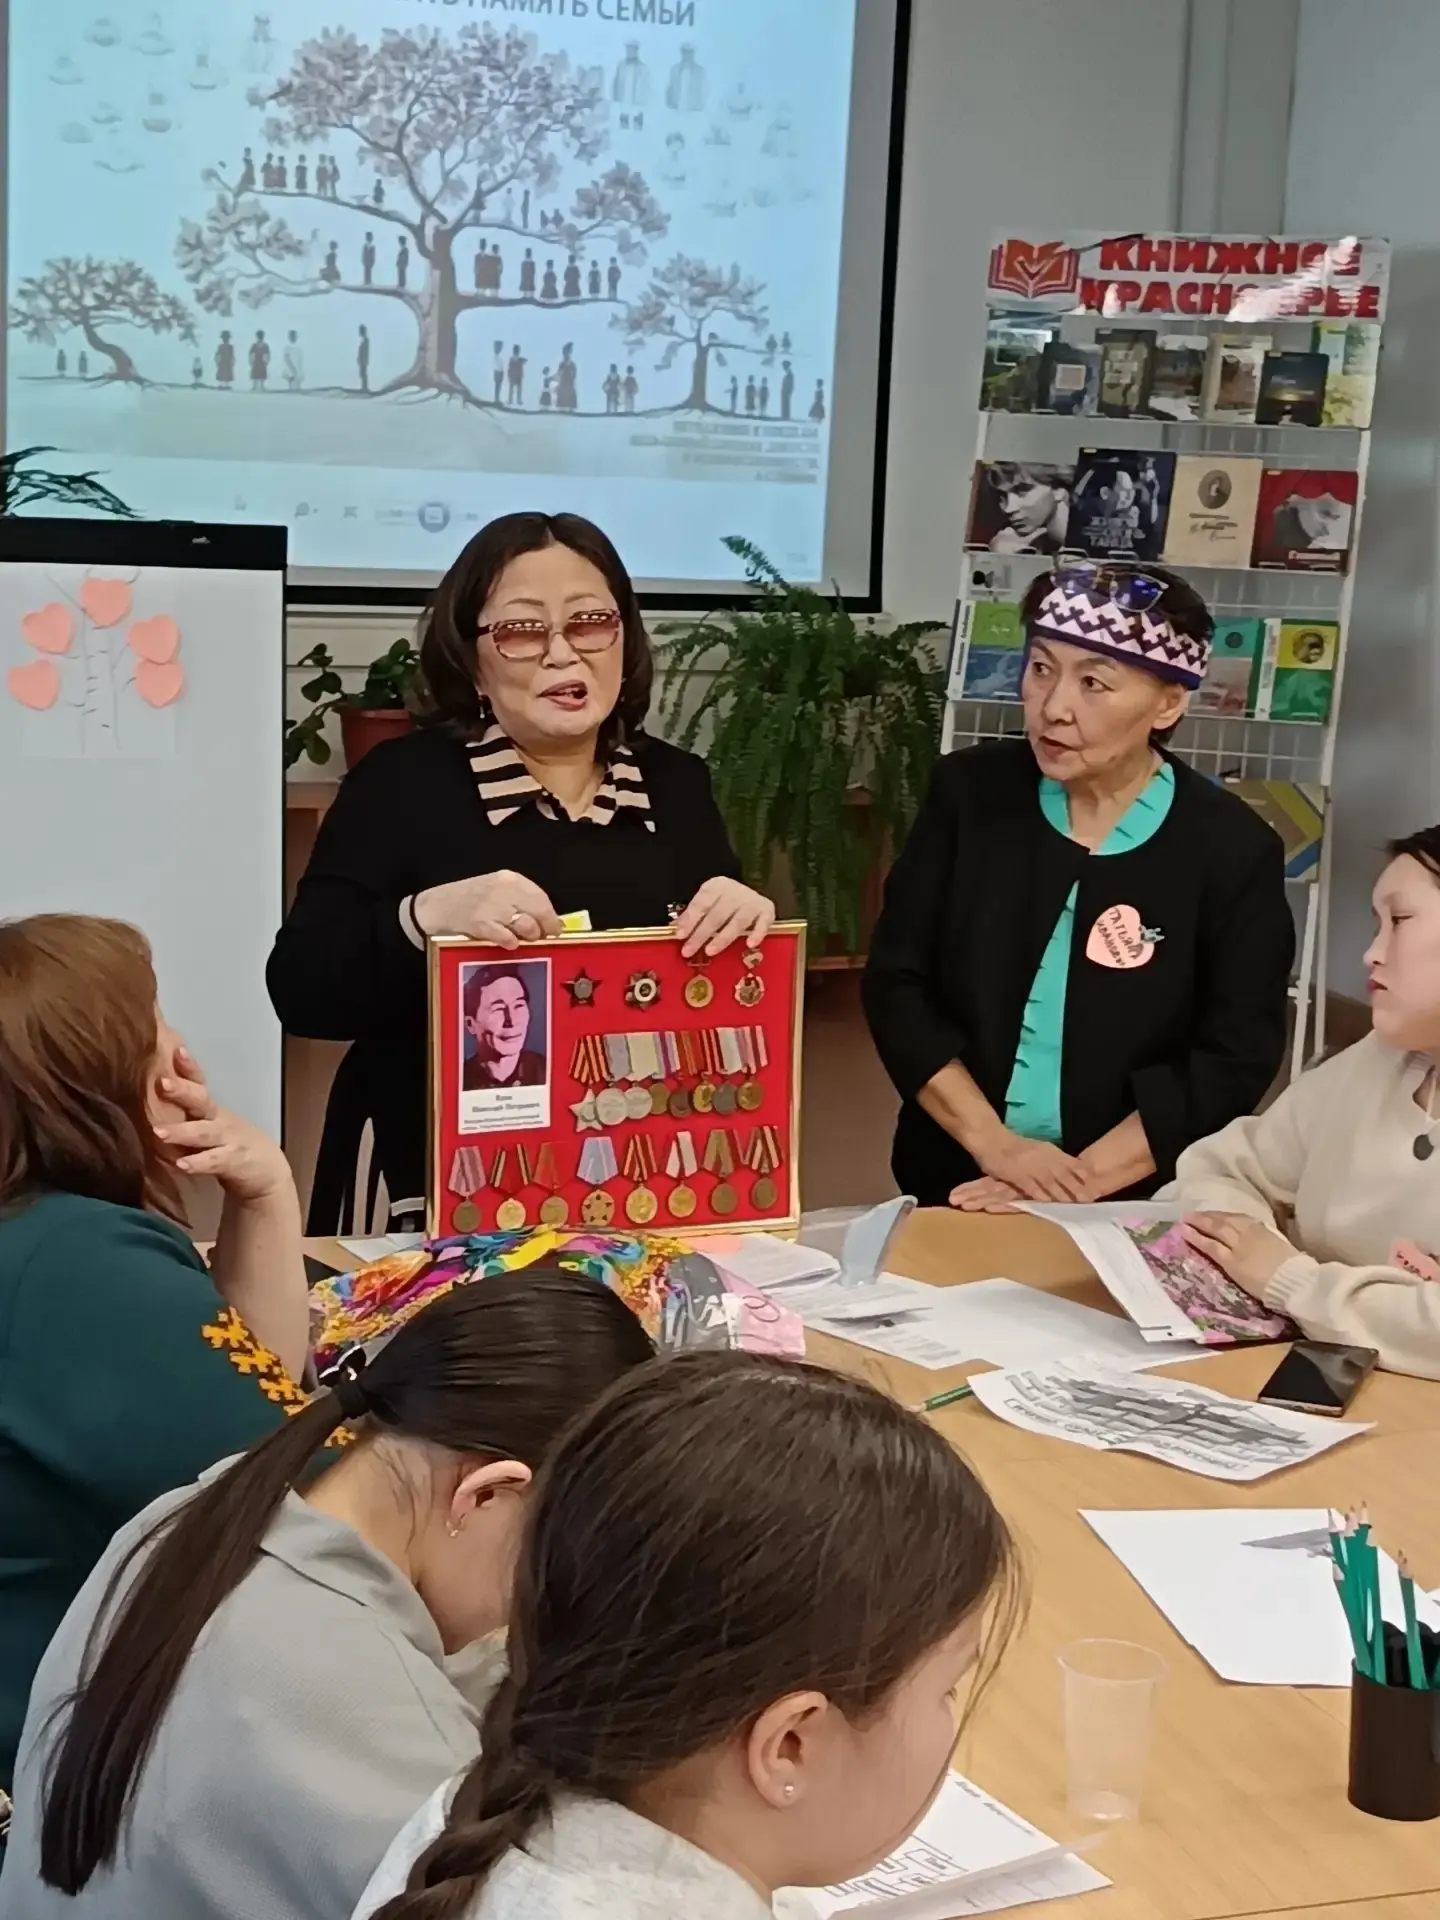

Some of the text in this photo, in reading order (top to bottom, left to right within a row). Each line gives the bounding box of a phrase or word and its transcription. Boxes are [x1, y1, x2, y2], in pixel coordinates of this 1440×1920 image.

[468, 0, 695, 27] ЯТЬ СЕМЬИ
[1100, 238, 1363, 276] КНИЖНОЕ
[1079, 277, 1381, 318] КРАСНРЬЕ
